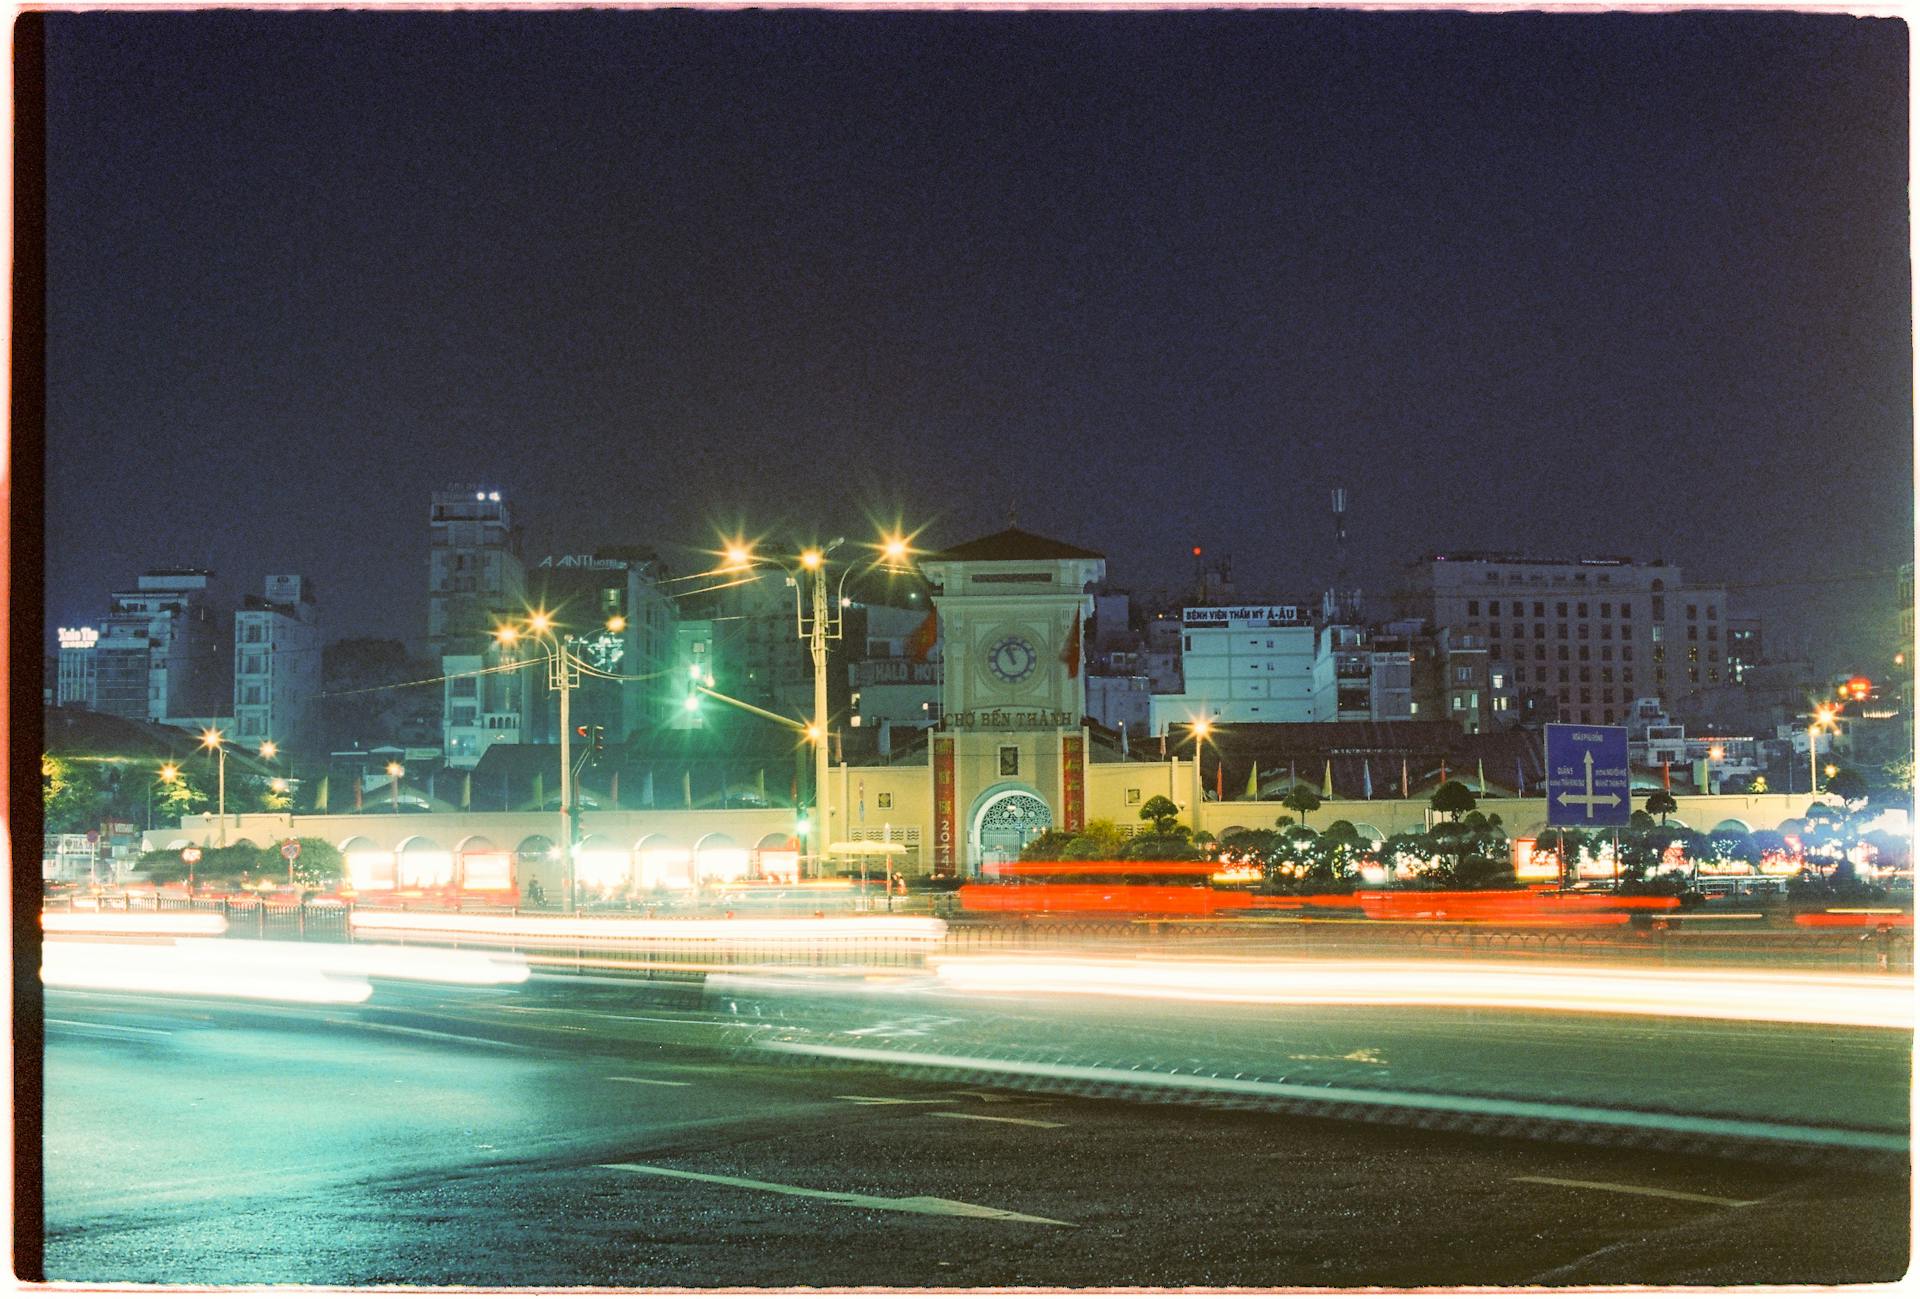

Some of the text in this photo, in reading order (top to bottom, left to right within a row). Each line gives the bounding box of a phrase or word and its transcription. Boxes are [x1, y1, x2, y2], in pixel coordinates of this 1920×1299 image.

[944, 708, 1073, 729] CHỢ BẾN THÀNH
[941, 820, 950, 866] 2024
